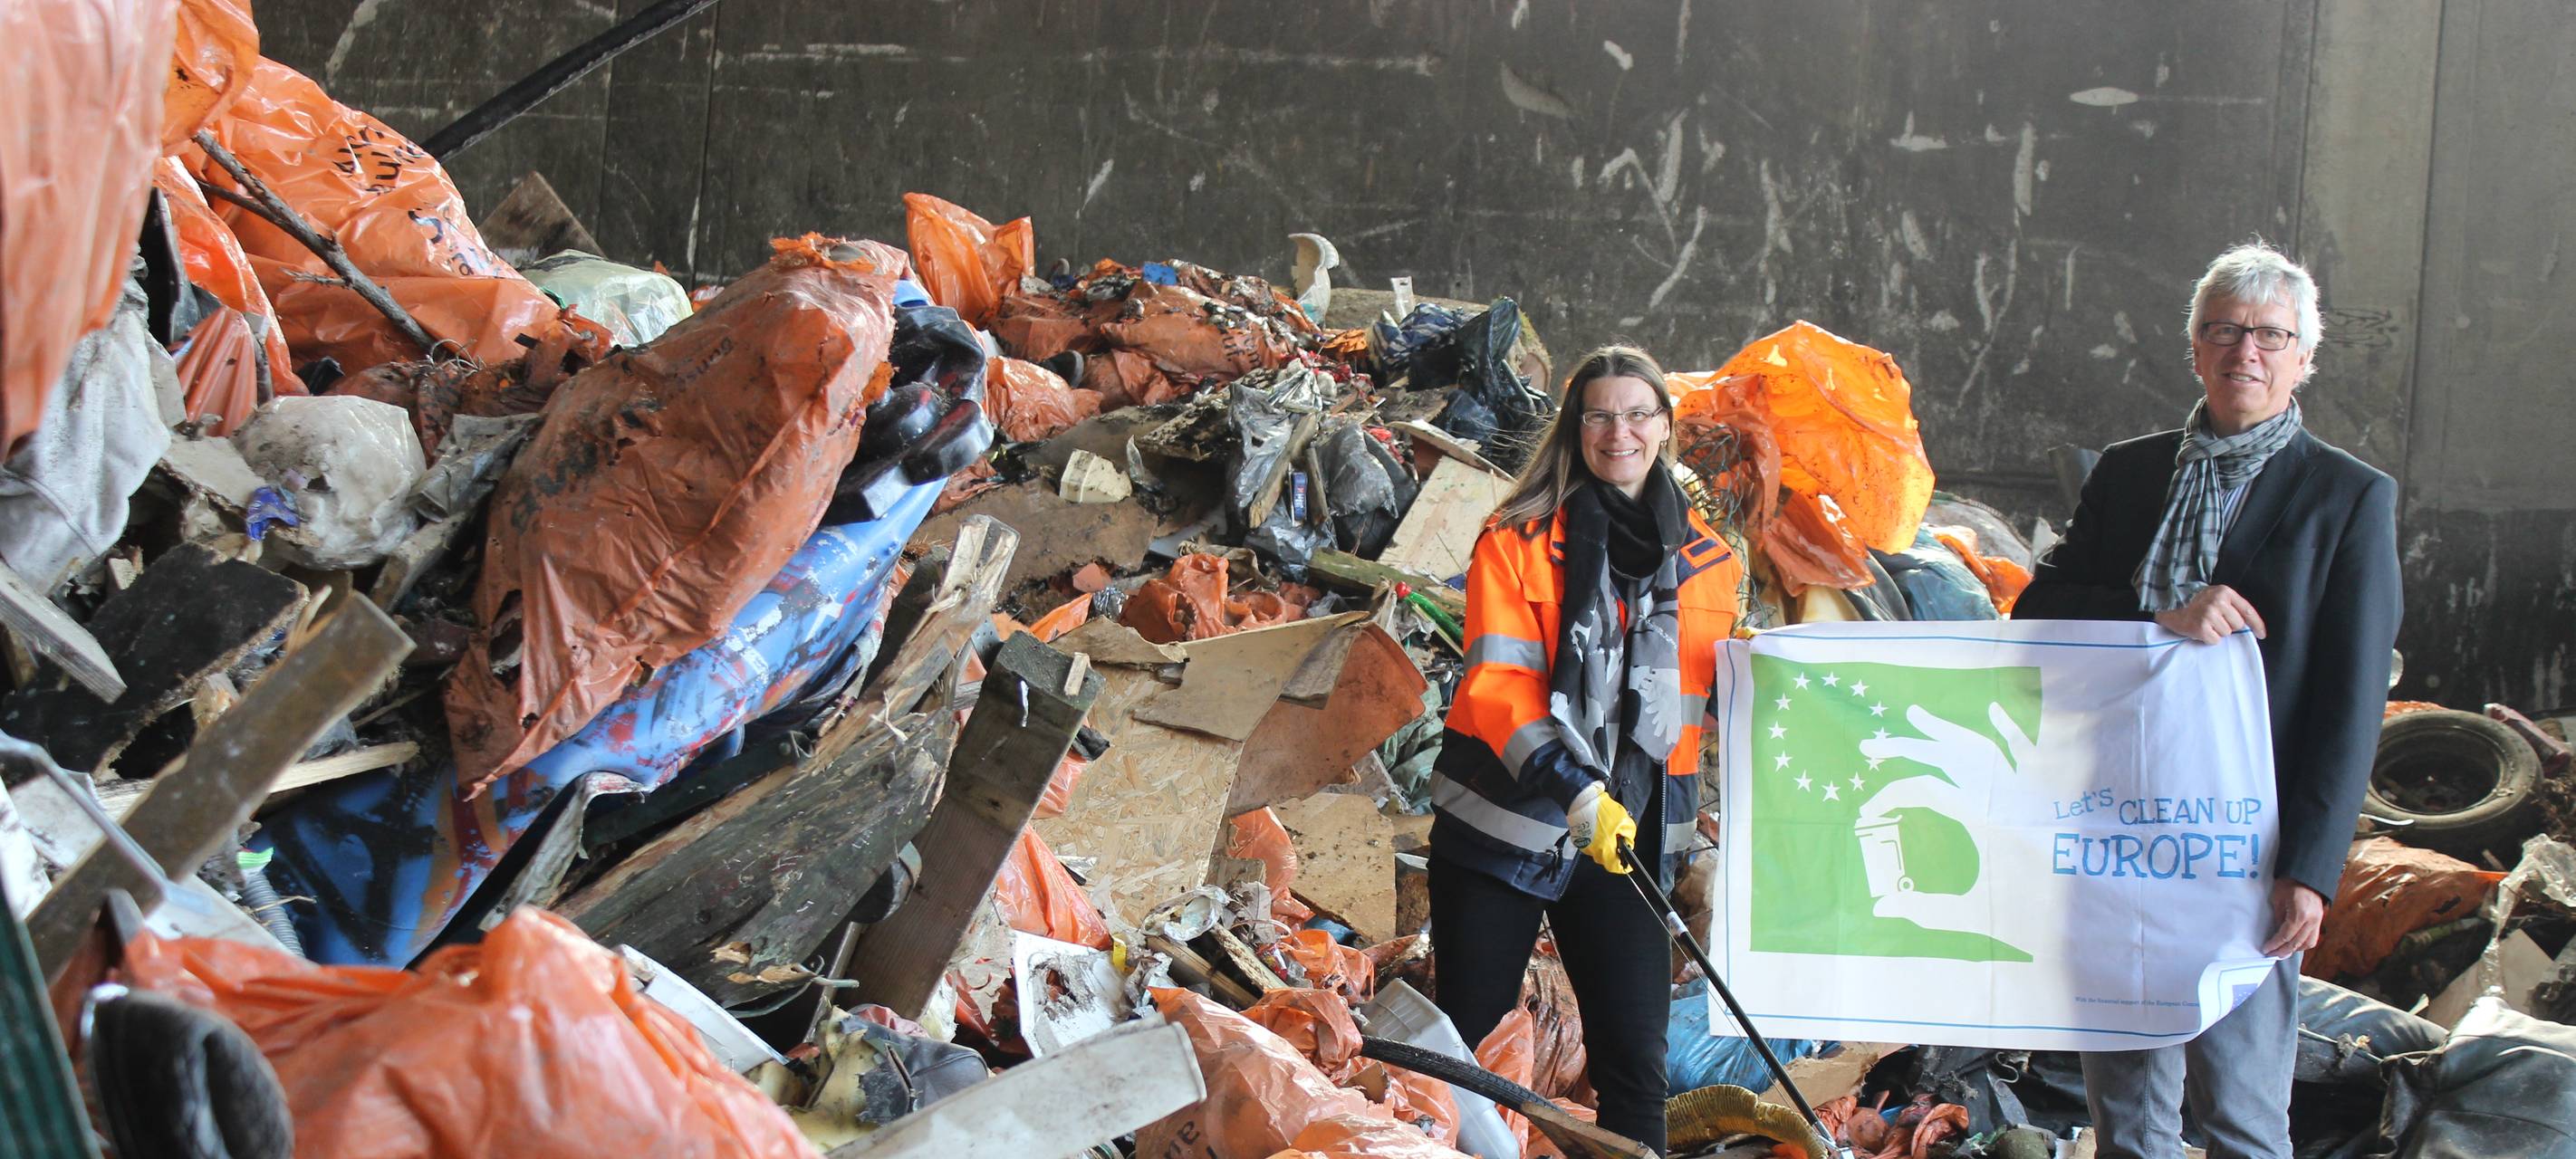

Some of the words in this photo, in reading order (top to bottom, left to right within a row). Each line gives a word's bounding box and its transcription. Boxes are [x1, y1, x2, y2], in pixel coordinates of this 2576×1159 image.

[2053, 787, 2114, 819] Let's
[2119, 797, 2215, 825] CLEAN
[2225, 798, 2263, 825] UP
[2052, 832, 2260, 879] EUROPE!
